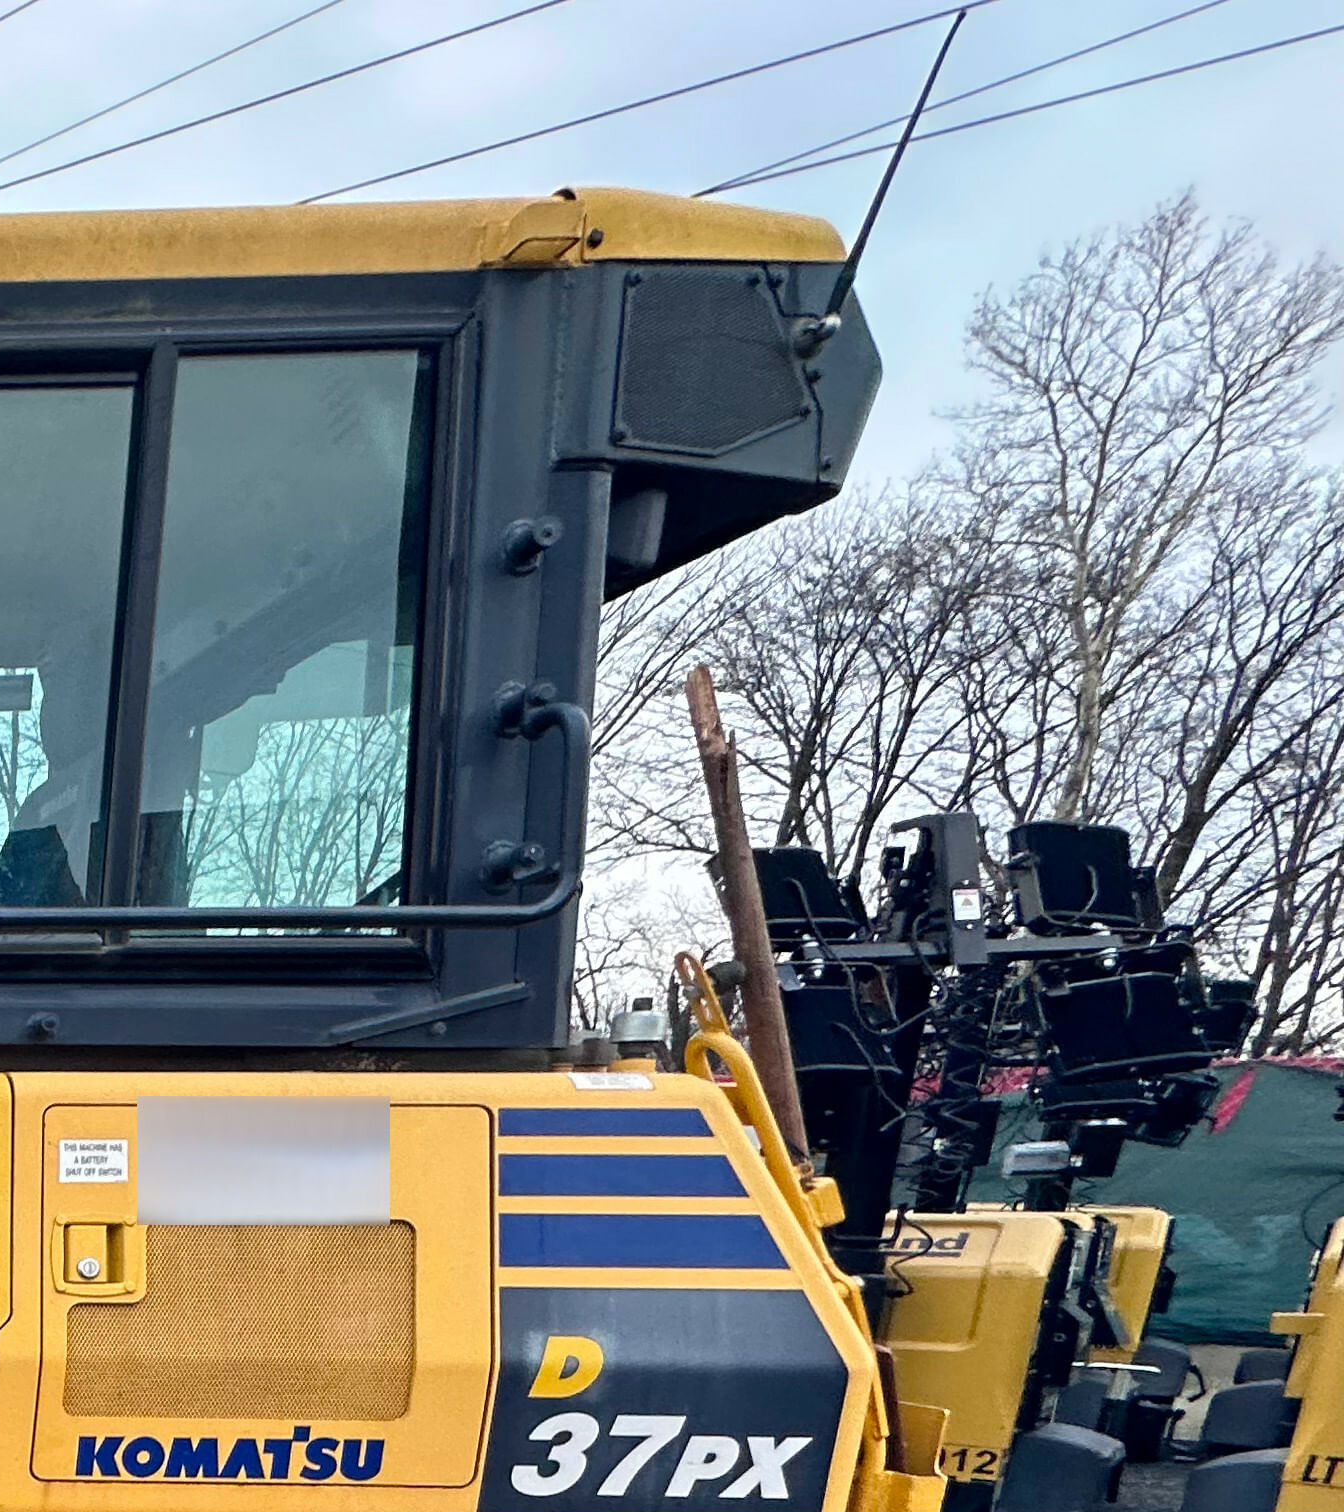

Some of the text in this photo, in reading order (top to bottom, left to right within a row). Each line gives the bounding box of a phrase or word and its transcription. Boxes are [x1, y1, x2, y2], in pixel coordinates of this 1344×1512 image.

[79, 1143, 107, 1151] MACHINE
[81, 1156, 108, 1164] BATTERY
[84, 1168, 95, 1176] OFF
[528, 1335, 604, 1398] D
[75, 1426, 385, 1481] KOMATSU
[511, 1412, 814, 1499] 37PX
